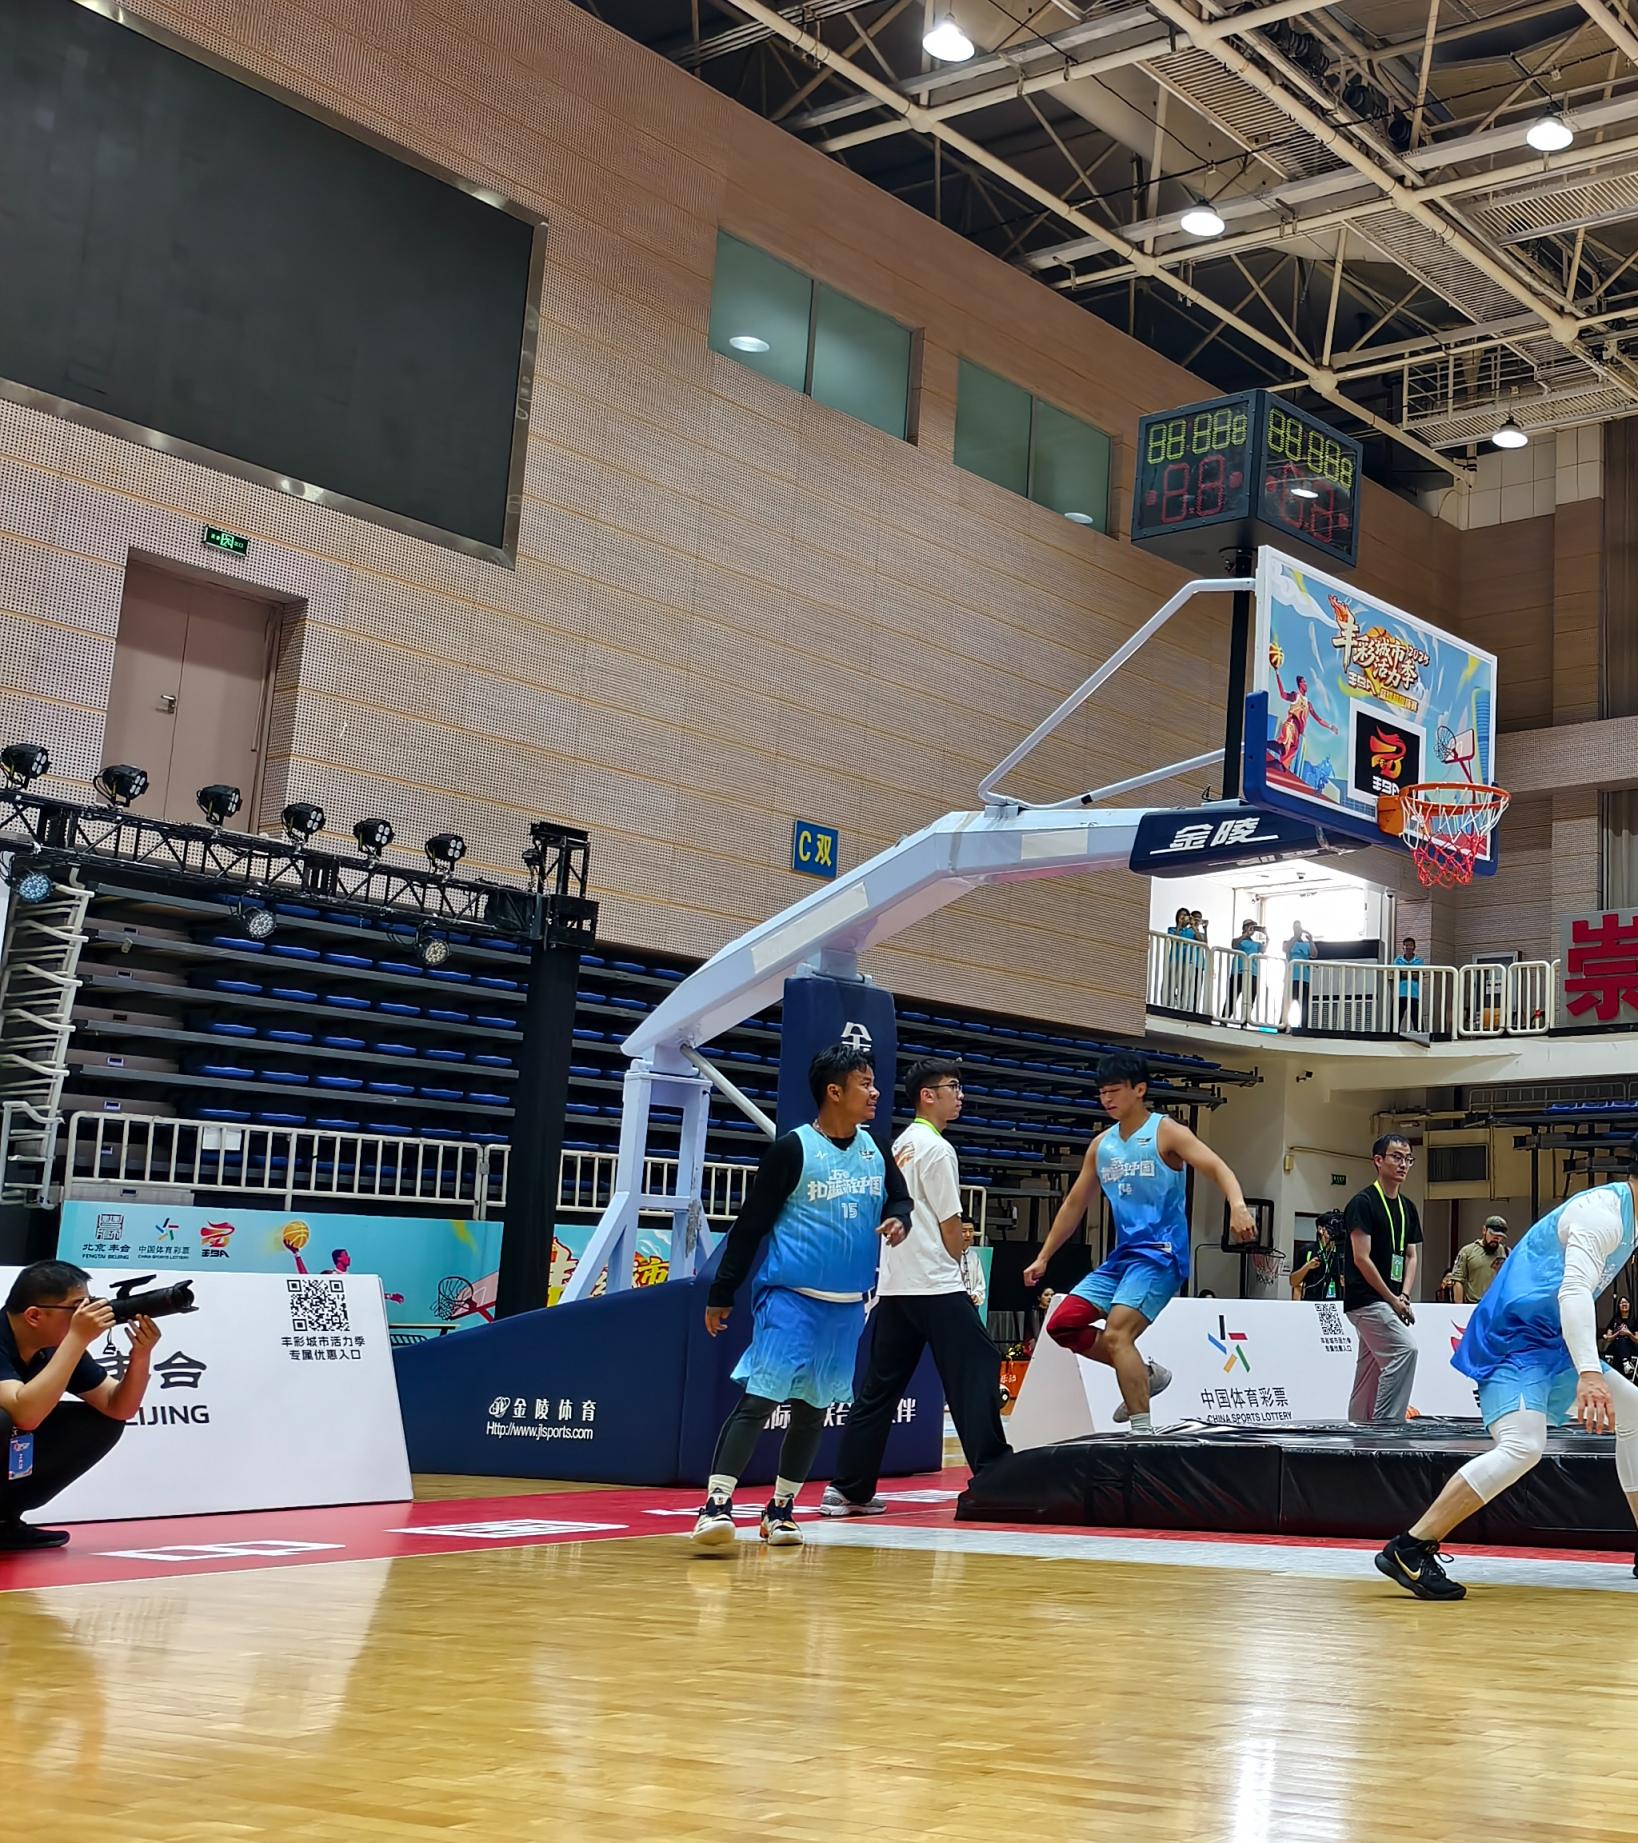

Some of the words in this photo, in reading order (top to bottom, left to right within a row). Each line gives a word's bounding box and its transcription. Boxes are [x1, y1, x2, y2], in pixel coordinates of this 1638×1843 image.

[1160, 817, 1272, 850] 金陵
[841, 1202, 858, 1219] 15
[138, 1245, 190, 1255] 中国体育彩票
[281, 1336, 366, 1347] 丰彩城市活力季
[289, 1349, 361, 1360] 专属优惠入口
[1201, 1387, 1289, 1410] 中国体育彩票
[512, 1398, 596, 1421] 金陵体育
[1207, 1414, 1231, 1423] CHINA
[1231, 1412, 1260, 1424] SPORTS
[1261, 1411, 1293, 1421] LOTTERY
[486, 1421, 594, 1441] Http://www.jlsports.com
